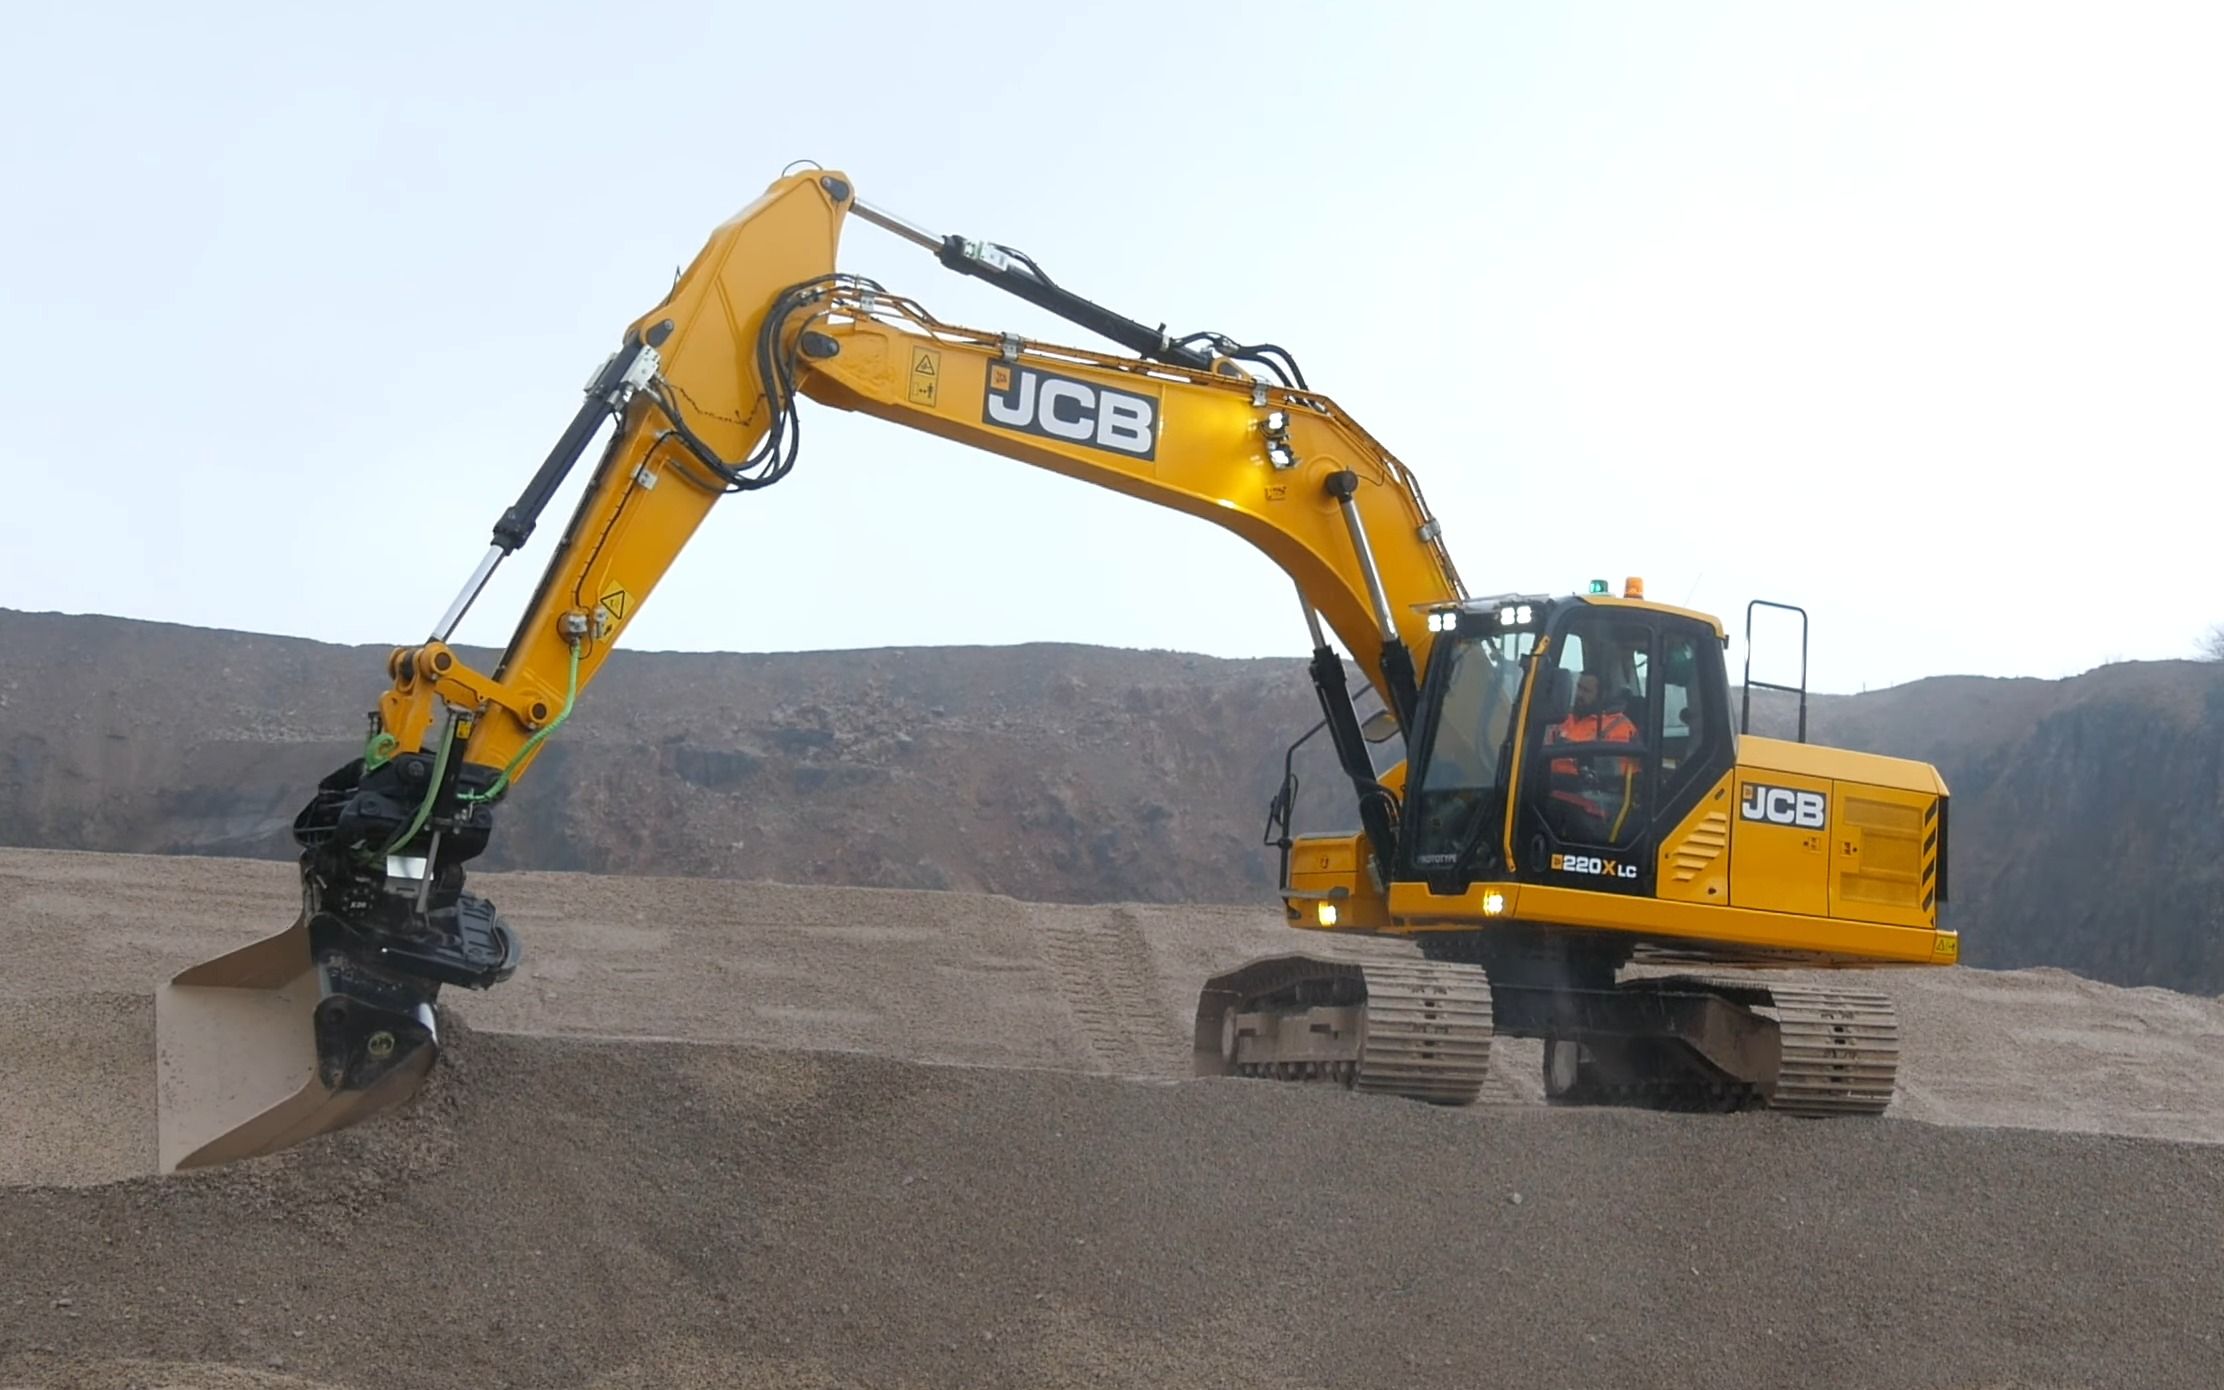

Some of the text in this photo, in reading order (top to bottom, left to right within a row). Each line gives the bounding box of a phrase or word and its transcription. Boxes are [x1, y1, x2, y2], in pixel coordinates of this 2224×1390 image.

[988, 371, 1153, 454] JCB
[1742, 786, 1825, 828] JCB
[1617, 864, 1637, 878] LC
